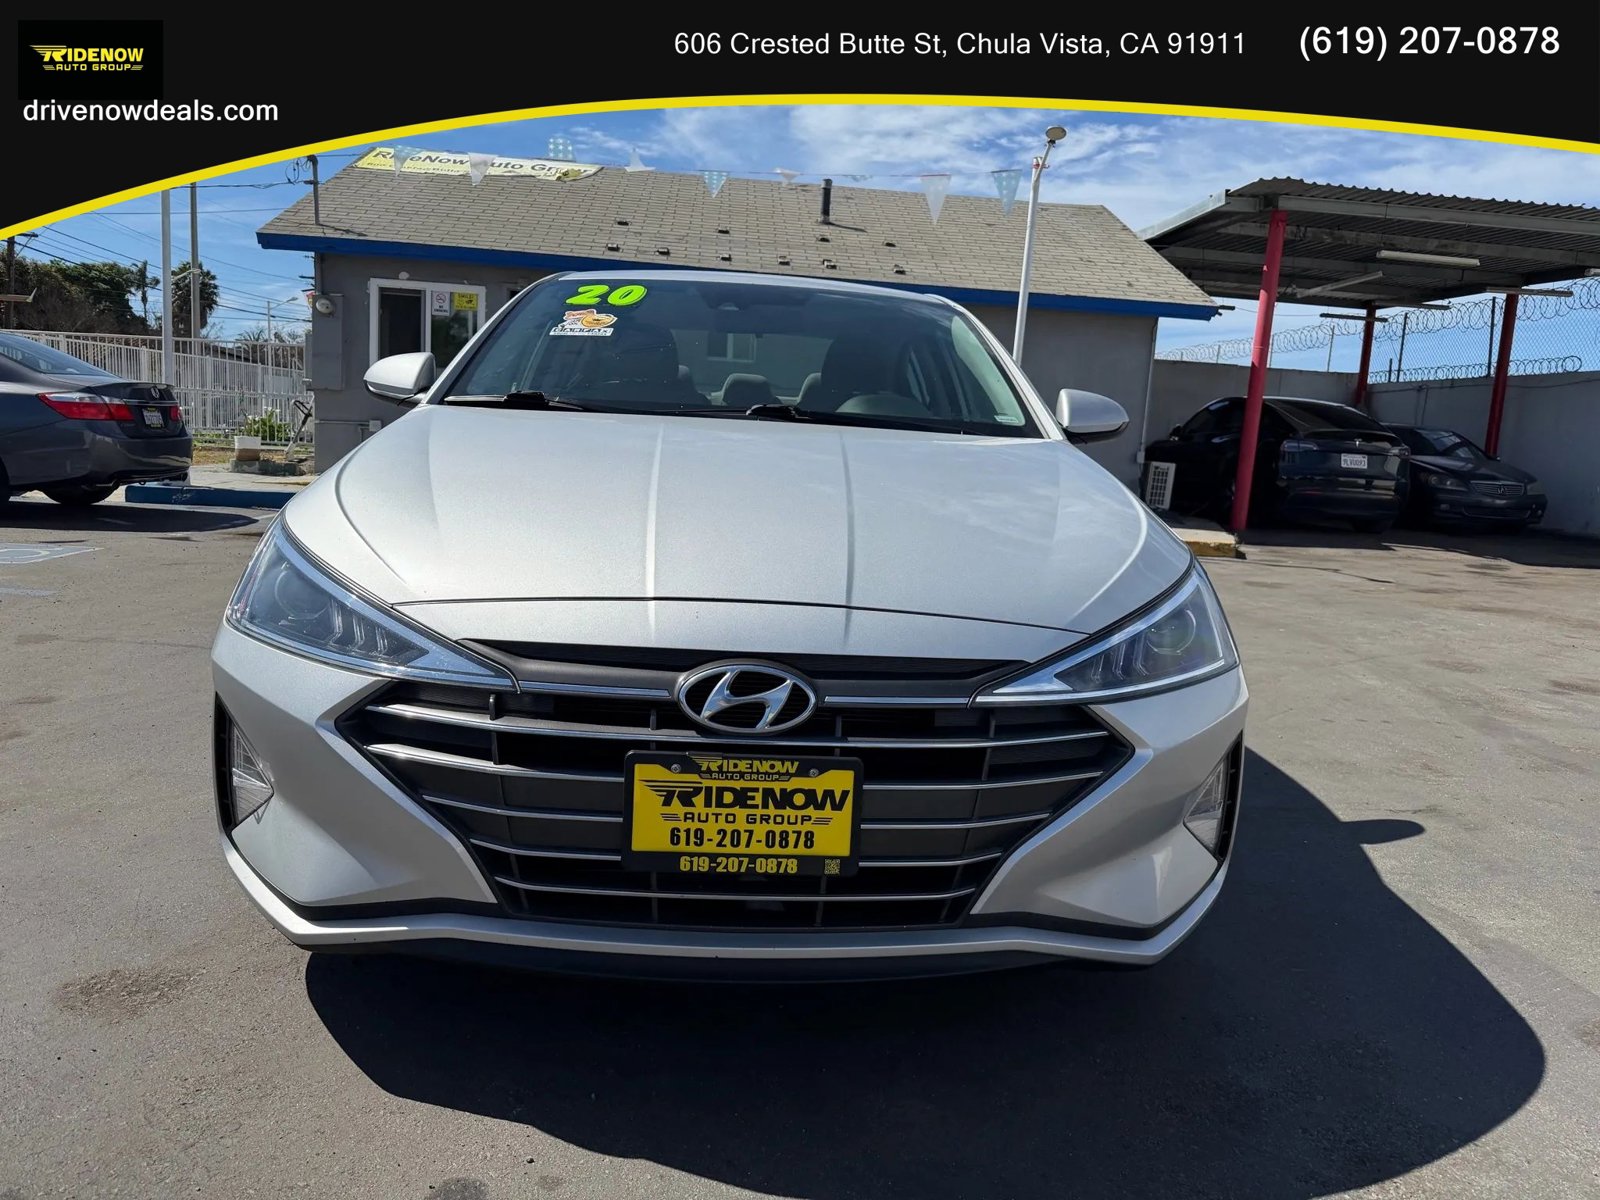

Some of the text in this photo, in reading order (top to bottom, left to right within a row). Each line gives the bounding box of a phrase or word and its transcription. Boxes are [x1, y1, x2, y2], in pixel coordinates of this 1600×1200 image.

[565, 285, 648, 306] 20
[692, 756, 799, 774] RIDENOW
[641, 780, 851, 812] RIDENOW
[683, 812, 813, 826] AUTO GROUP
[669, 827, 815, 849] 619-207-0878
[679, 855, 798, 874] 619-207-0878
